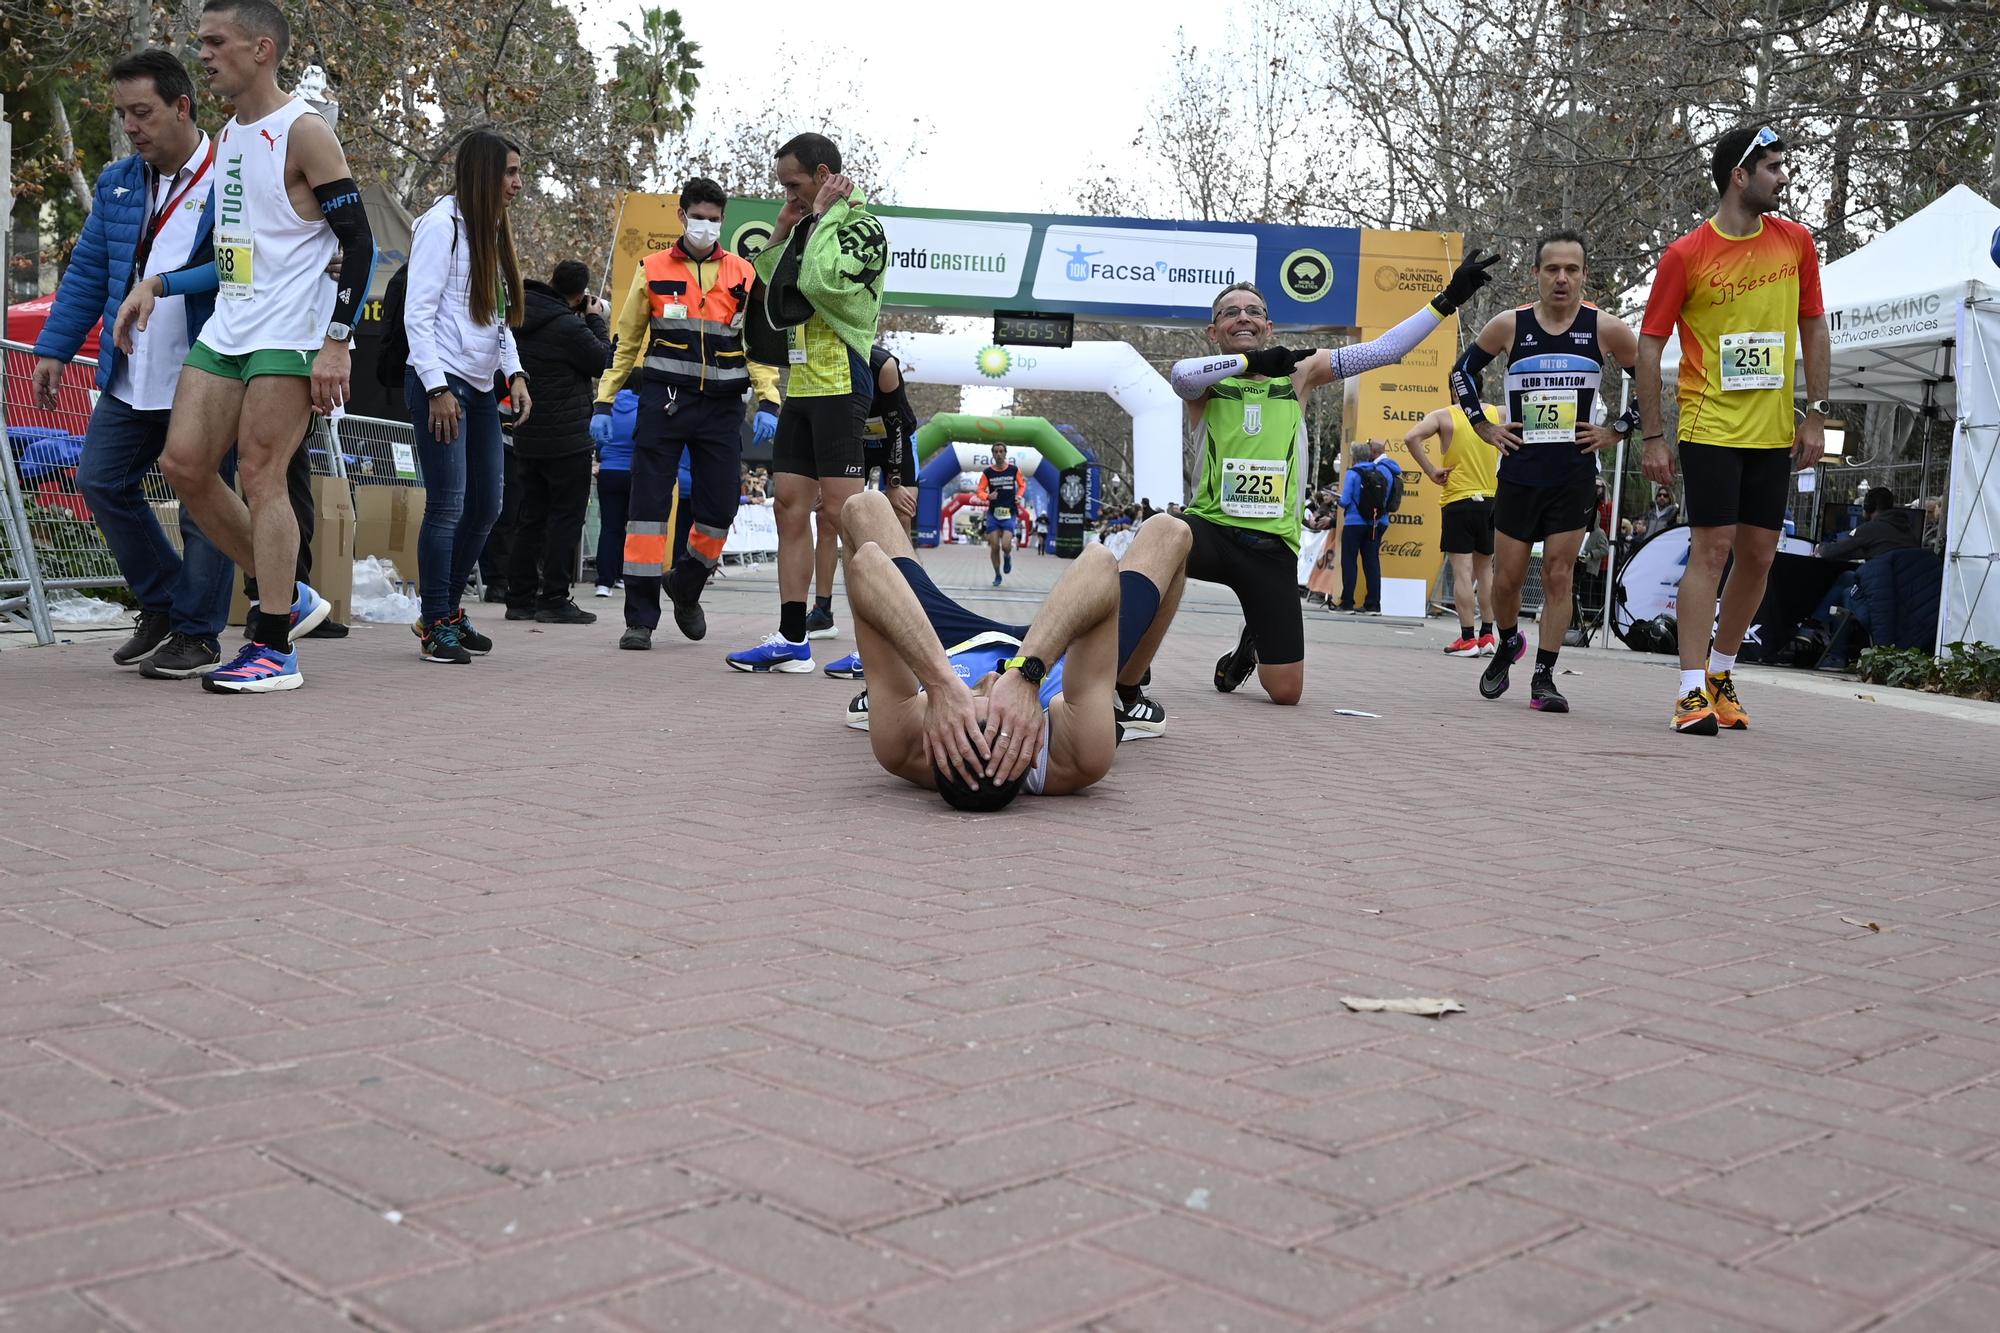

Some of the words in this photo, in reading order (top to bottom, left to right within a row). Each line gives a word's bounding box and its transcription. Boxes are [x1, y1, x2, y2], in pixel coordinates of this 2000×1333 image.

[218, 247, 235, 272] 68
[930, 251, 1006, 273] CASTELLÓ
[1069, 262, 1088, 279] 10K
[1090, 263, 1157, 283] Facsa
[1168, 266, 1236, 286] CASTELLÓ
[1399, 272, 1443, 283] RUNNING
[1736, 263, 1797, 296] Seseña
[1851, 294, 1941, 328] BACKING
[998, 321, 1070, 340] 2:56:54
[1017, 354, 1038, 370] bp
[1539, 358, 1568, 369] MITOS
[1735, 347, 1771, 368] 251
[1740, 367, 1770, 376] DANIEL
[1398, 384, 1439, 393] CASTELLÓN
[1521, 377, 1542, 388] CLUB
[1543, 376, 1586, 387] TRIATLON
[1535, 404, 1559, 422] 75
[1534, 422, 1559, 430] MIRON
[1234, 474, 1273, 496] 225
[1225, 494, 1281, 504] JAVIERBALMA
